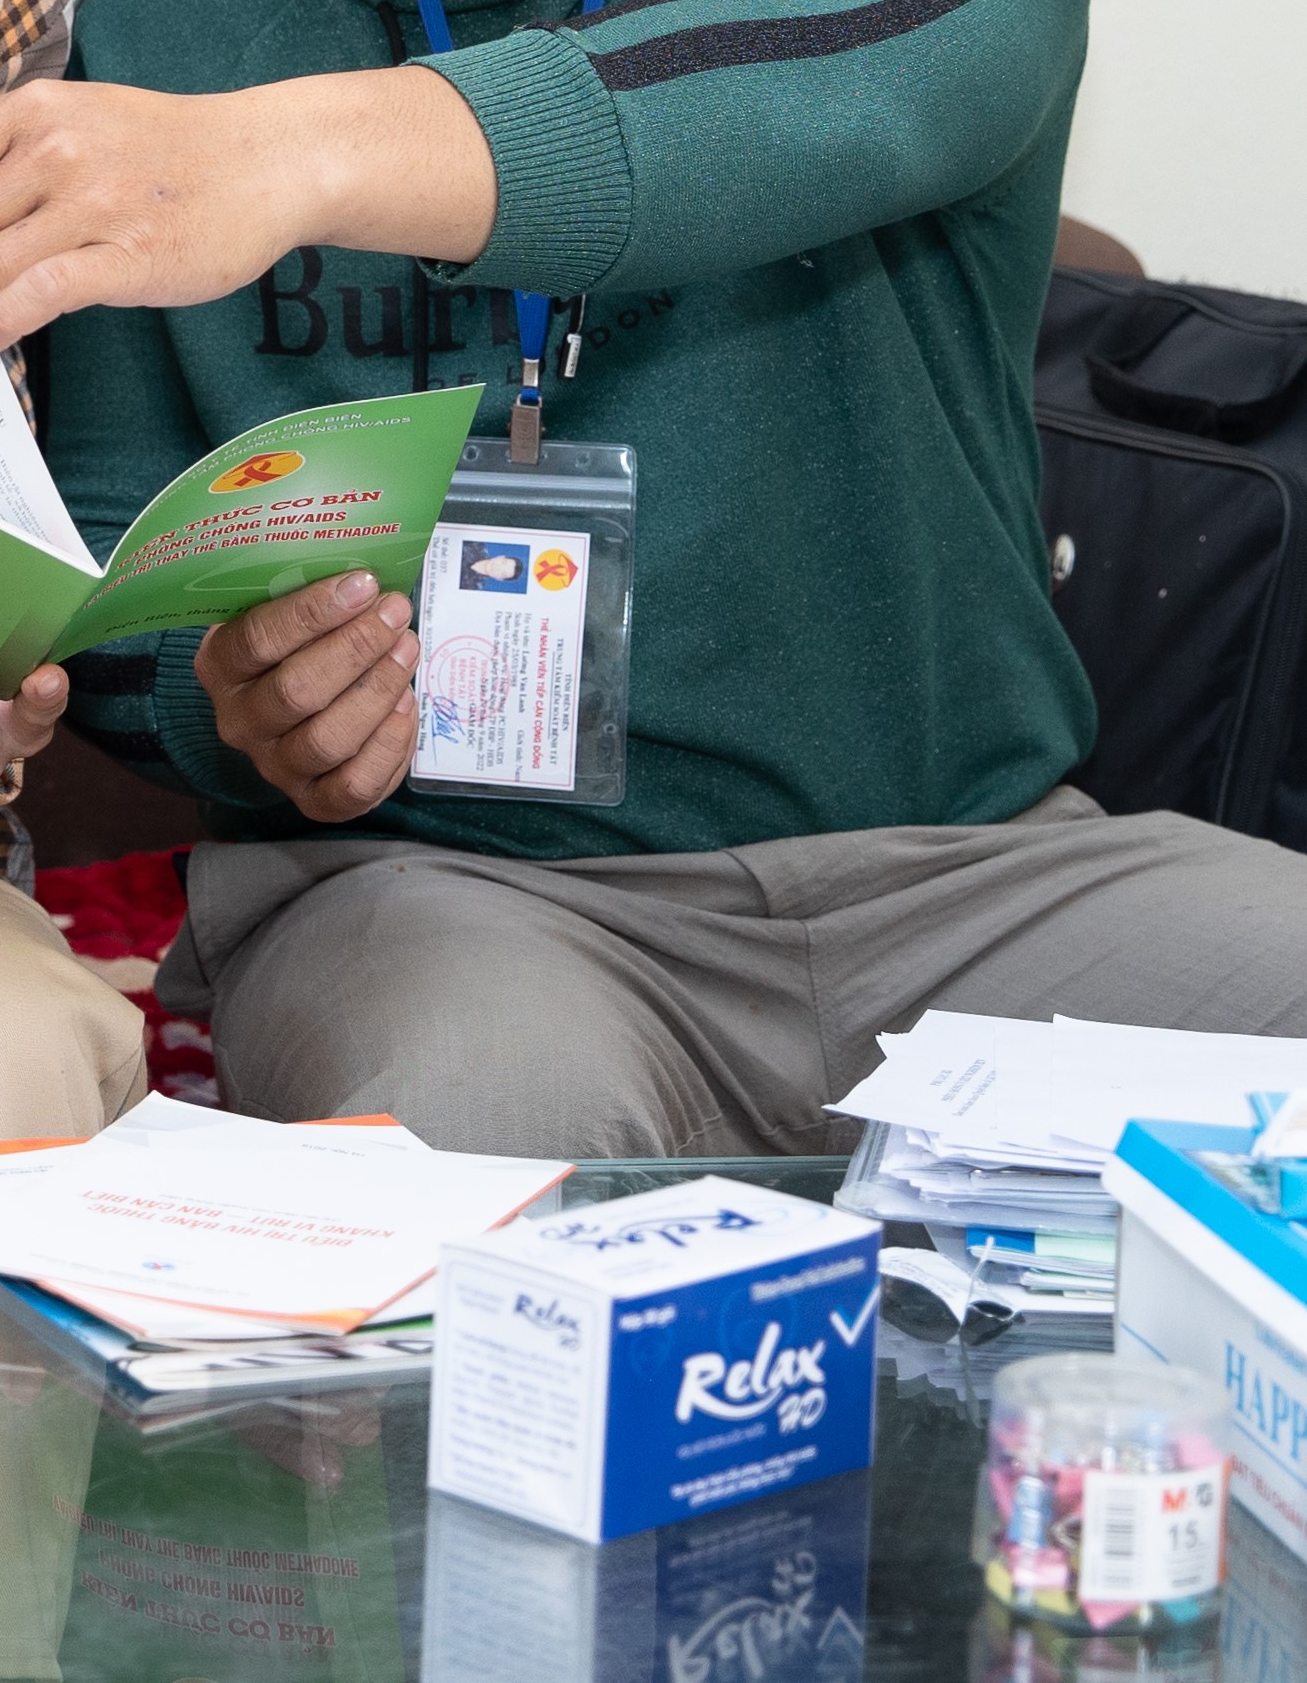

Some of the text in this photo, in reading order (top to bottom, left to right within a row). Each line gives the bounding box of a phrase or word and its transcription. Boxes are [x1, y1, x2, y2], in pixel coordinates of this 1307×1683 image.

[324, 412, 363, 423] BIÊN
[342, 415, 412, 430] HIV/AIDS
[183, 504, 264, 533] THỨC
[270, 496, 316, 512] CƠ
[320, 487, 383, 507] BẢN
[134, 511, 348, 566] PHÒNG CHỐNG HIV/AIDS
[155, 548, 191, 568] THAY
[192, 540, 220, 557] THẾ
[220, 532, 261, 550] BẰNG
[263, 527, 310, 543] THUỐC
[313, 522, 402, 540] METHADONE
[531, 617, 552, 769] THẺ NHÂN VIÊN TIẾP CẬN CỘNG ĐỒNG
[495, 727, 505, 764] HIV/AIDS
[221, 1224, 260, 1237] HIV
[292, 1220, 316, 1232] VI
[675, 1321, 826, 1425] Relax
